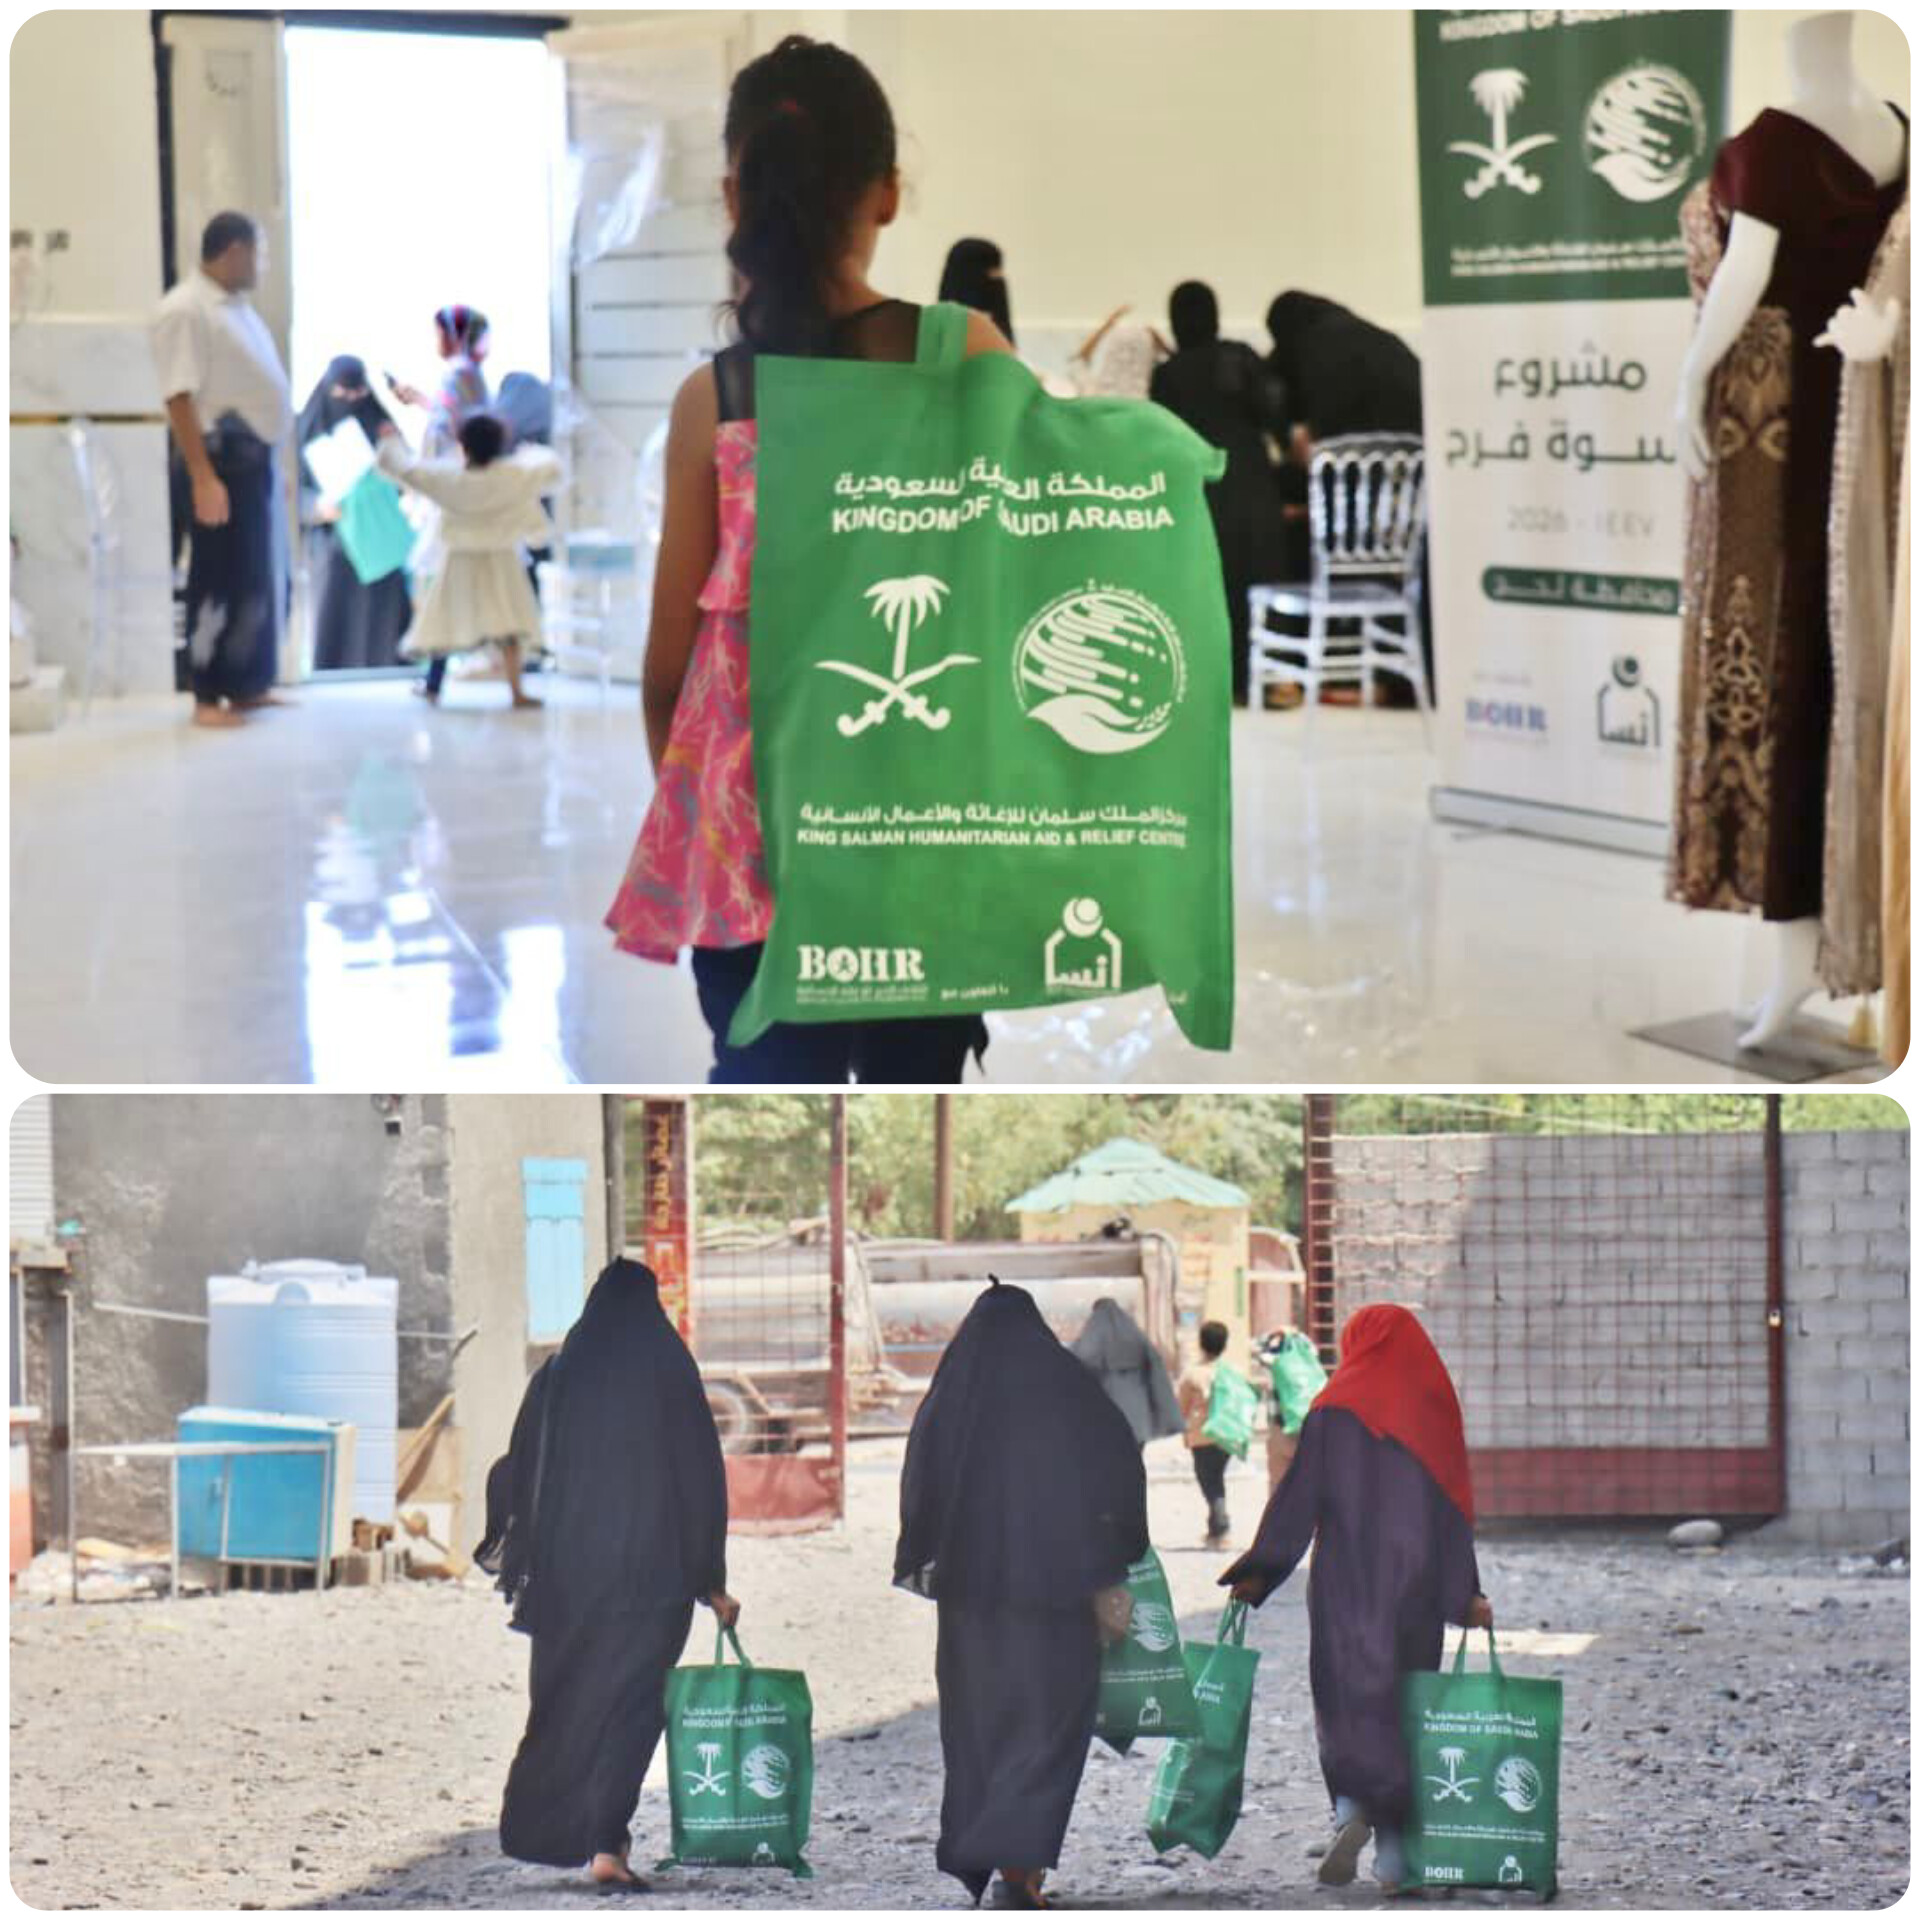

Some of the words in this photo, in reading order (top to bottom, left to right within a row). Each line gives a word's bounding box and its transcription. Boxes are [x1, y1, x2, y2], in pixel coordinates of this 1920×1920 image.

[1495, 340, 1647, 399] مشروع
[1446, 420, 1530, 468] فرح
[1047, 471, 1166, 500] المملكة
[832, 504, 958, 534] KINGDOM
[1065, 506, 1175, 531] ARABIA
[797, 829, 837, 846] KING
[841, 829, 906, 846] SALMAN
[909, 829, 1030, 846] HUMANITARIAN
[1034, 830, 1061, 846] AID
[1065, 831, 1077, 846] &
[1081, 829, 1135, 845] RELIEF
[797, 944, 926, 983] BOHR
